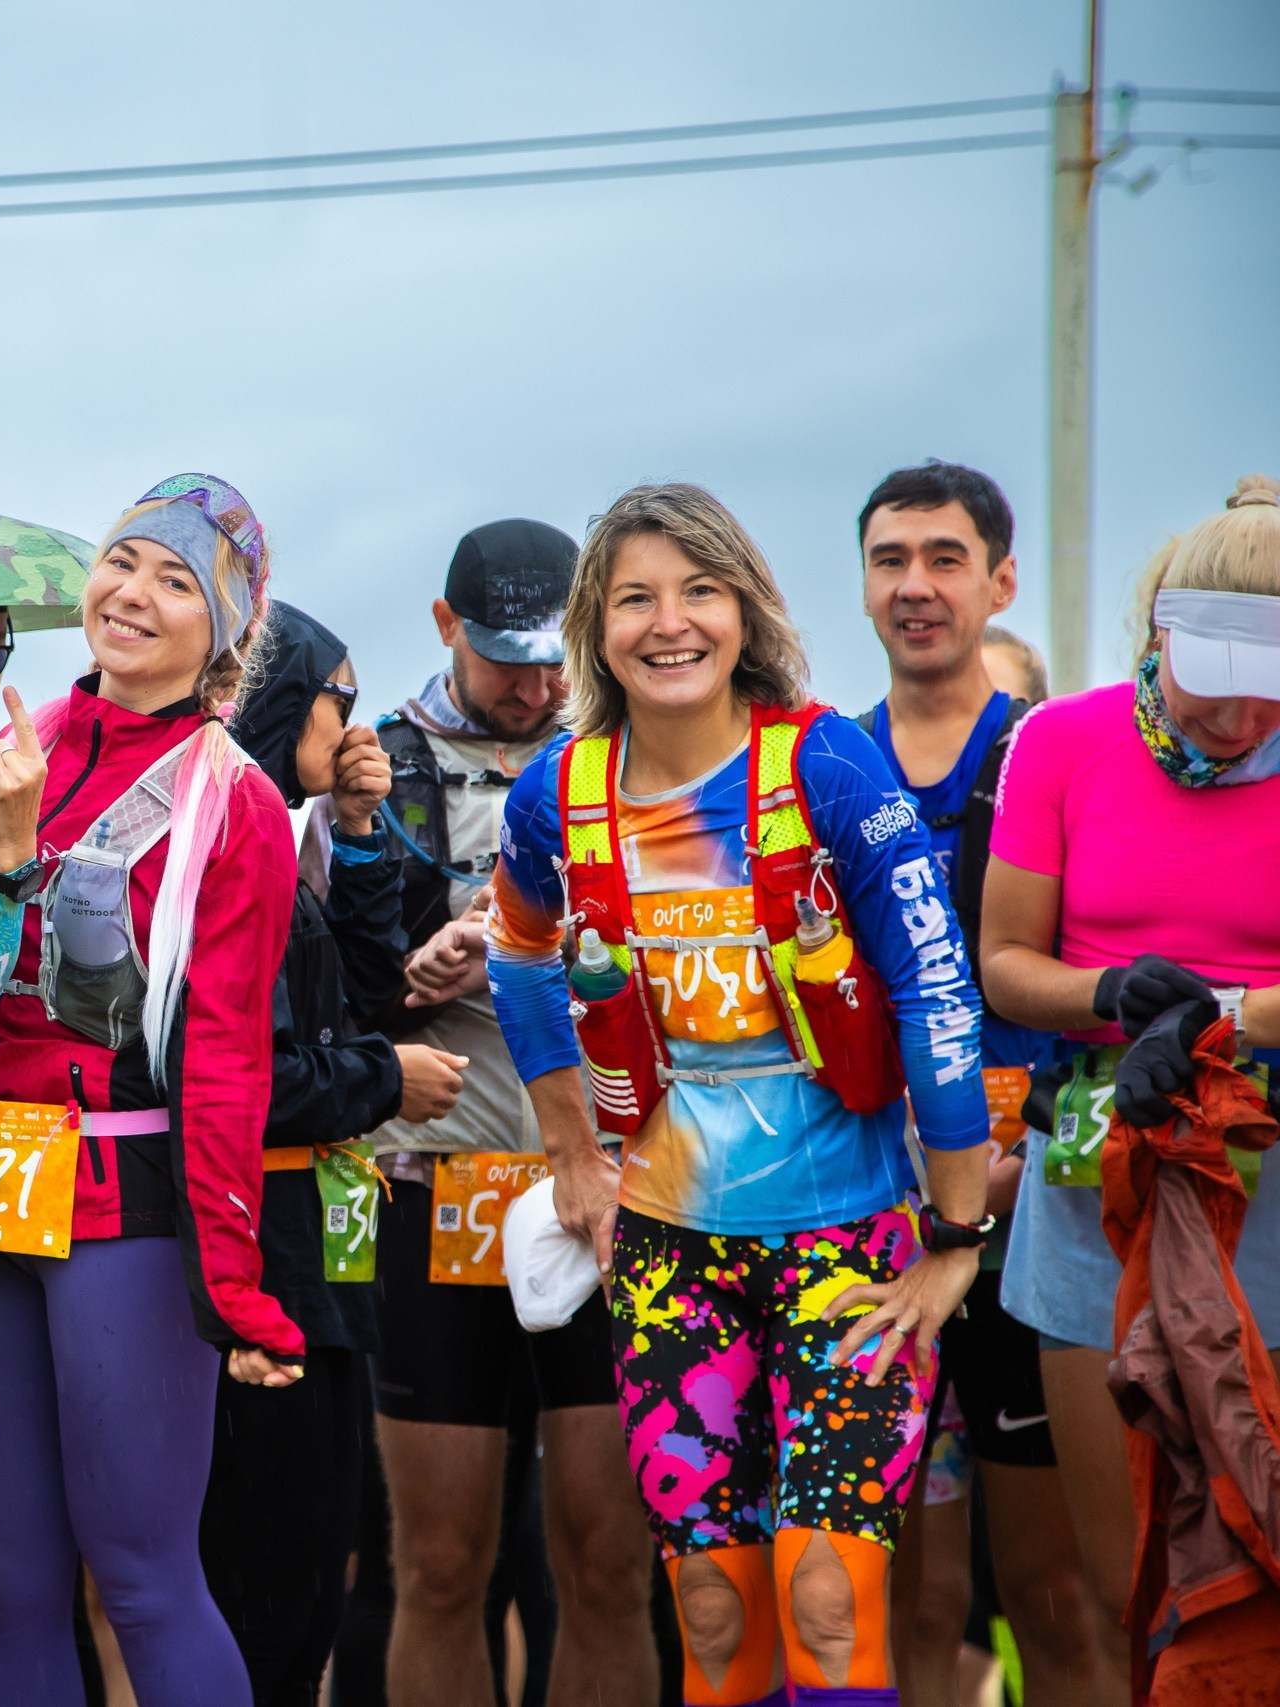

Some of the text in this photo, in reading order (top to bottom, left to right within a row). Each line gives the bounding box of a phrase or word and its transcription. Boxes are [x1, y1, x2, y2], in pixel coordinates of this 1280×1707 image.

[504, 603, 525, 616] WE
[653, 904, 690, 931] OUT
[693, 902, 714, 929] 50
[487, 1162, 526, 1188] OUT
